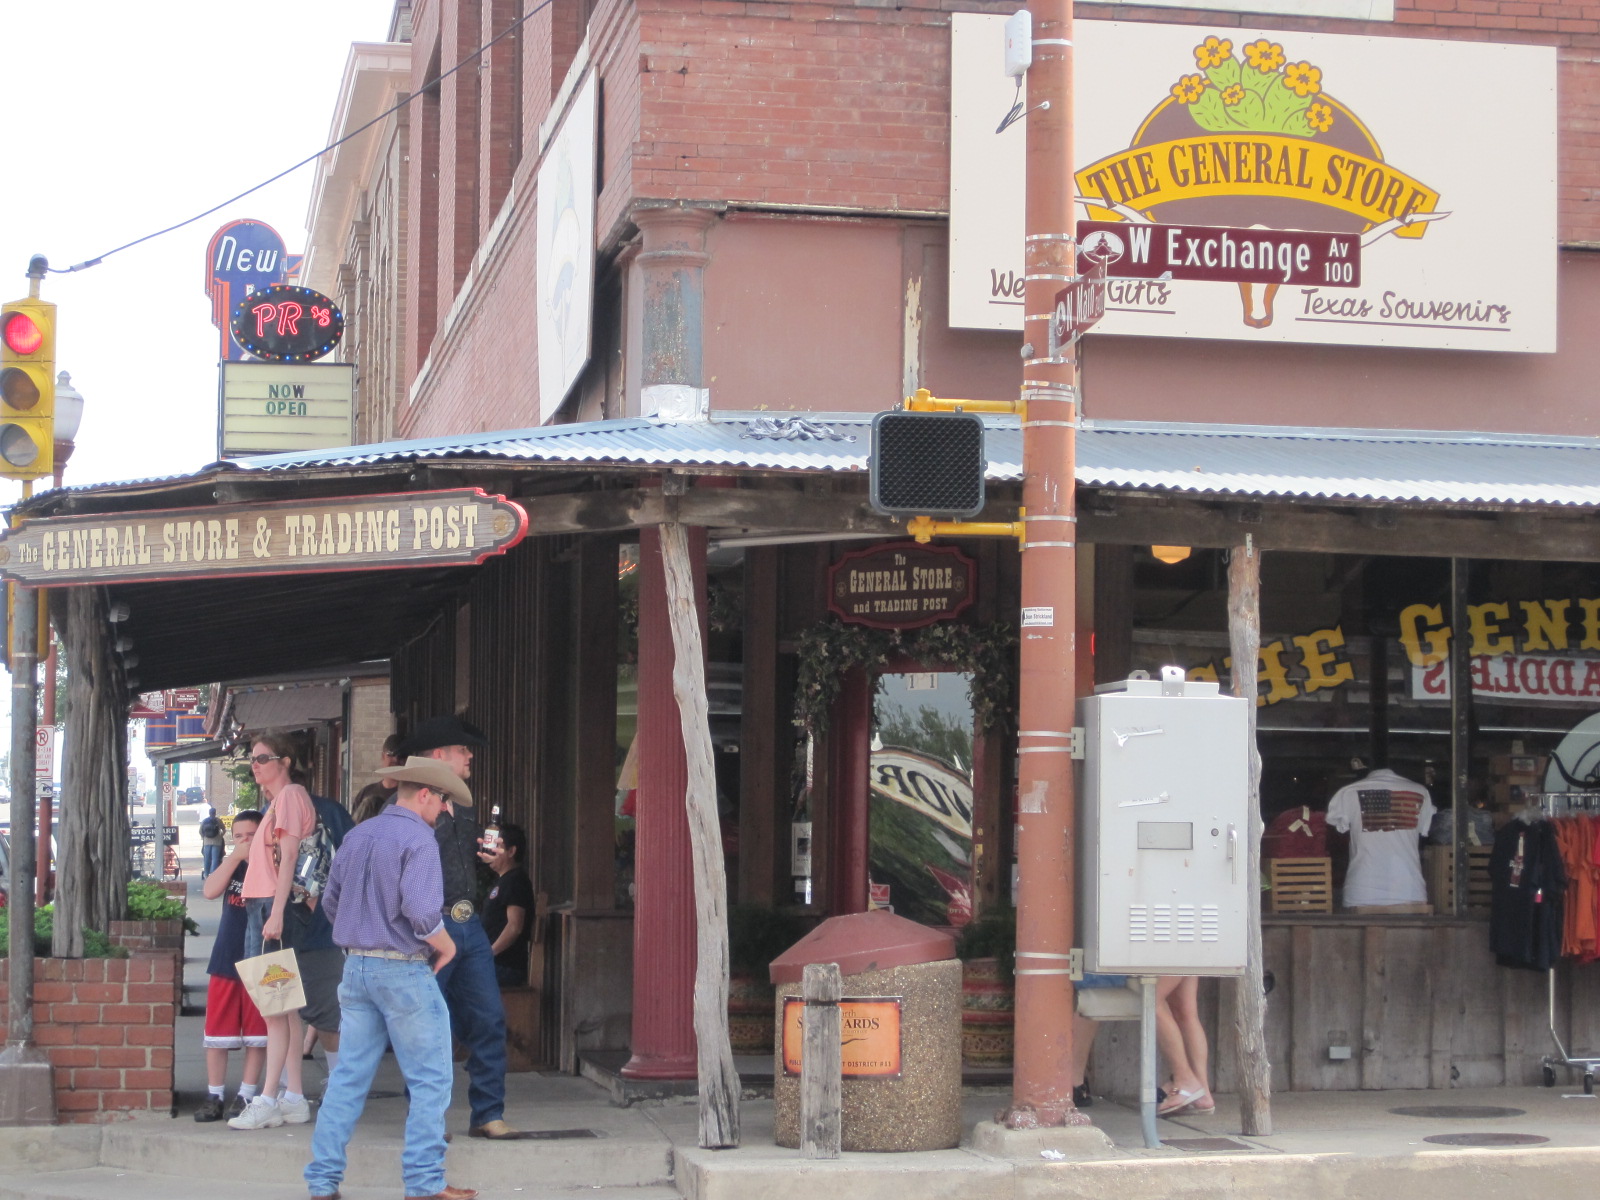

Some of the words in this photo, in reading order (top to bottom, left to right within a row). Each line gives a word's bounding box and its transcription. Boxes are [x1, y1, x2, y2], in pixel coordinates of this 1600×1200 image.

[1086, 151, 1161, 210] THE
[1167, 141, 1313, 189] GENERAL
[1322, 153, 1427, 227] STORE
[215, 235, 279, 273] New
[1129, 227, 1152, 264] W
[1167, 228, 1310, 283] Exchange
[1329, 238, 1349, 257] Av
[1324, 262, 1353, 283] 100
[1066, 290, 1073, 332] N
[1077, 279, 1095, 326] Main
[1107, 280, 1172, 305] Gifts
[1300, 287, 1374, 318] Texas
[1379, 290, 1512, 324] Souvenirs
[268, 384, 305, 399] NOW
[265, 401, 307, 416] OPEN
[18, 543, 38, 564] The
[42, 525, 151, 572] GENERAL
[162, 518, 239, 563] STORE
[252, 516, 272, 558] &
[285, 509, 401, 556] TRADING
[412, 504, 478, 550] POST
[894, 553, 906, 566] The
[850, 569, 907, 593] GENERAL
[912, 566, 952, 590] STORE
[853, 601, 870, 613] and
[874, 598, 918, 613] TRADING
[922, 597, 948, 611] POST
[1187, 624, 1355, 708] HE
[131, 828, 177, 836] STOCKRD
[140, 834, 172, 842] SALN
